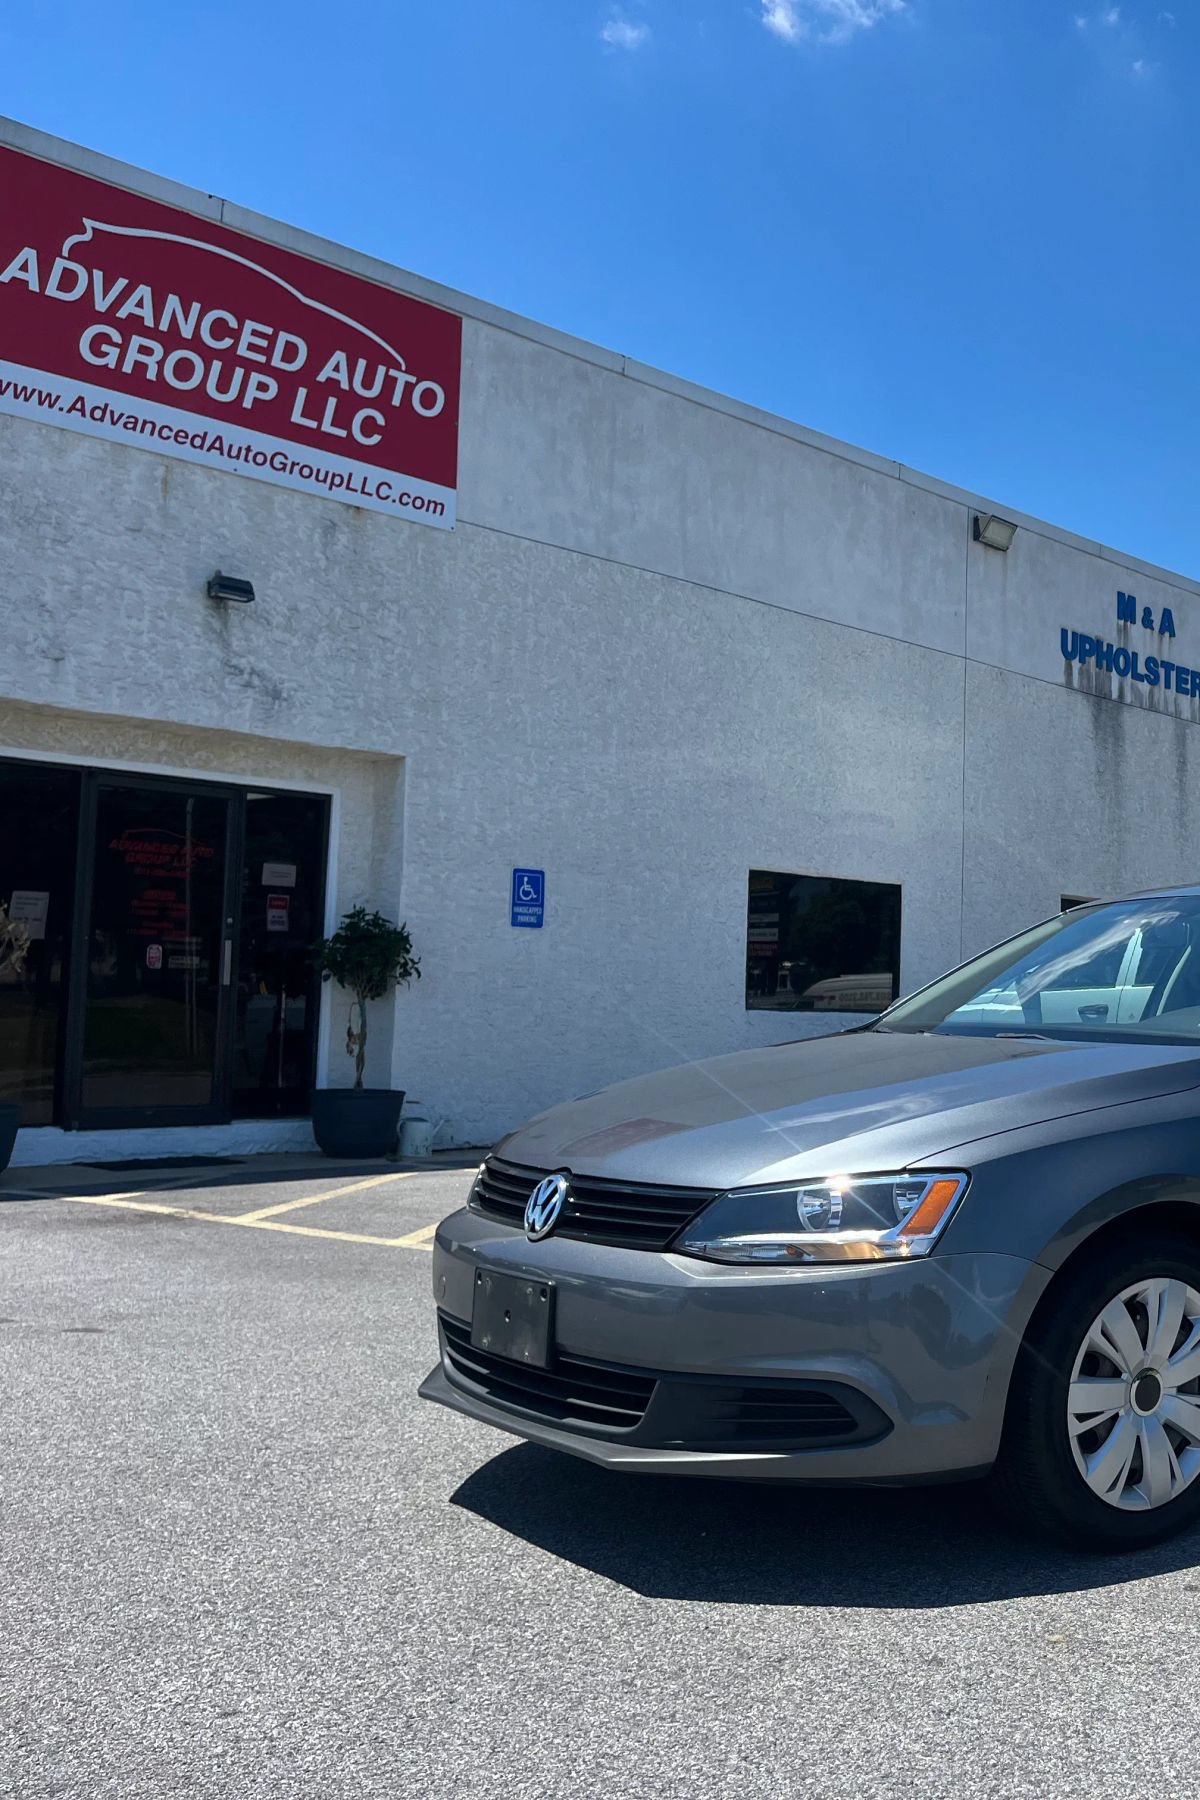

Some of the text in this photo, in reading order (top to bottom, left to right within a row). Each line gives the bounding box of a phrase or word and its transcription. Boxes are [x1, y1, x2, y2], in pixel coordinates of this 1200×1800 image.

[0, 247, 445, 418] ADVANCED AUTO
[79, 324, 386, 446] GROUP LLC
[1117, 591, 1176, 637] M & A
